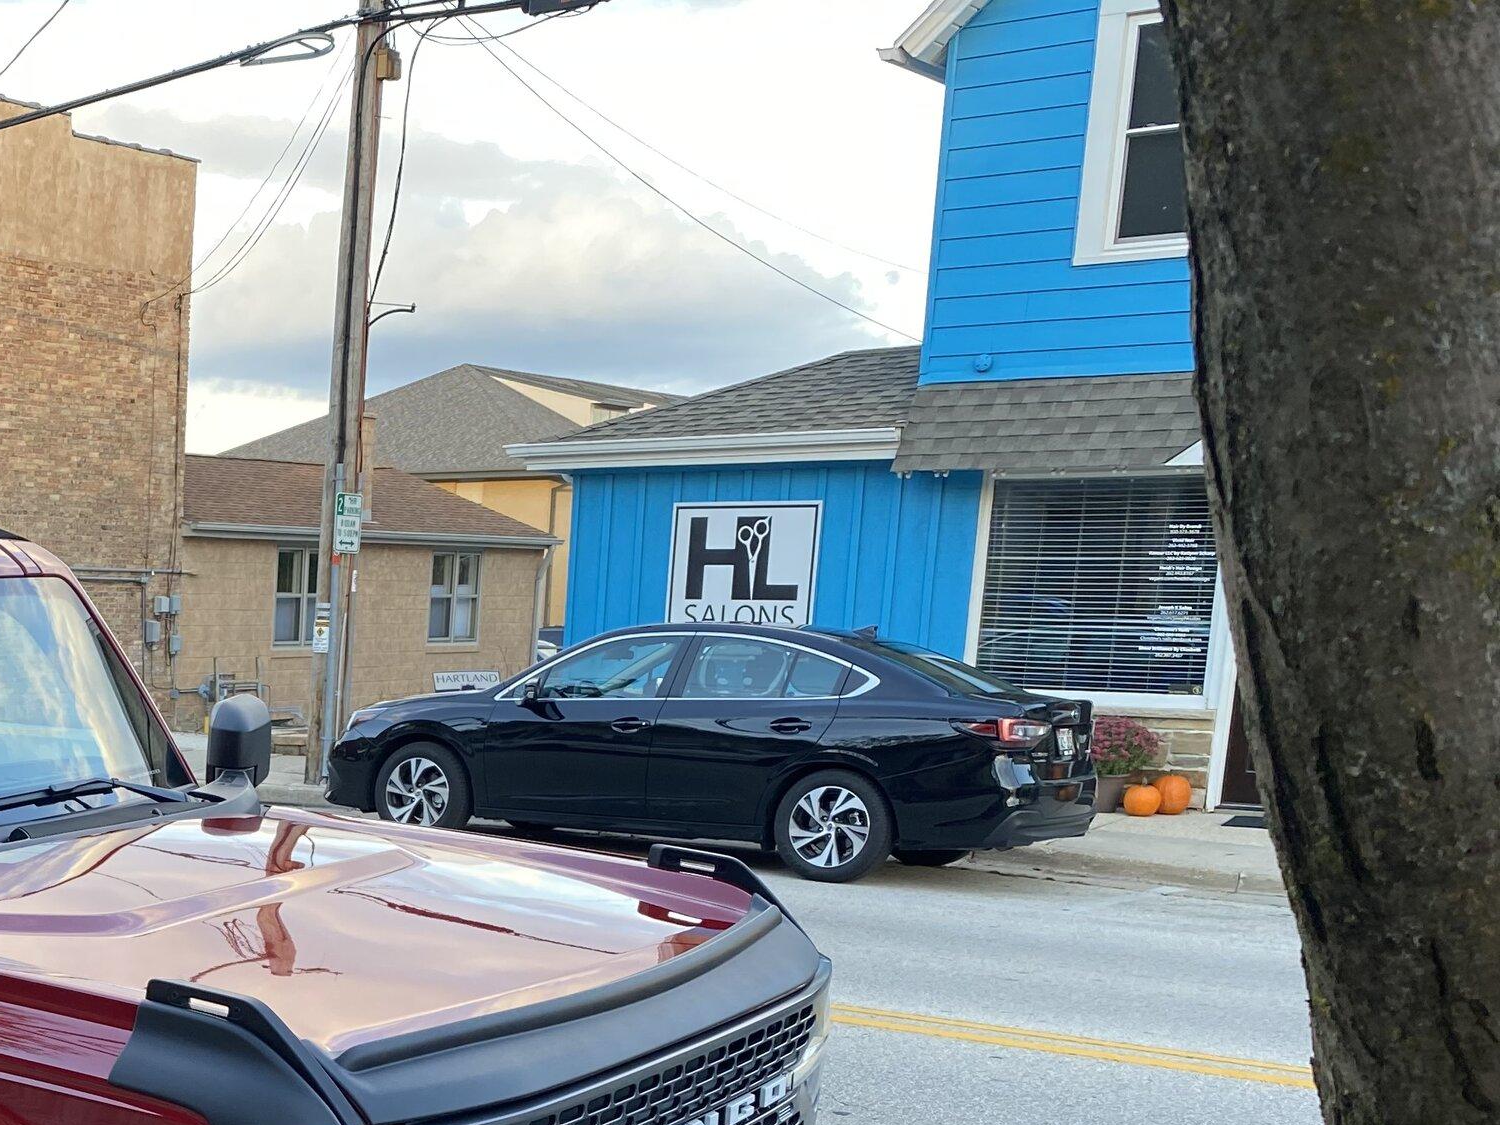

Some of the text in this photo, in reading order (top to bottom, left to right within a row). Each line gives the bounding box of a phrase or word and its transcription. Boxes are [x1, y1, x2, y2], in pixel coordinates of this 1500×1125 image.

[338, 497, 343, 512] 2
[685, 516, 799, 600] HL
[685, 604, 794, 623] SALONS
[436, 674, 498, 683] HARTLAND
